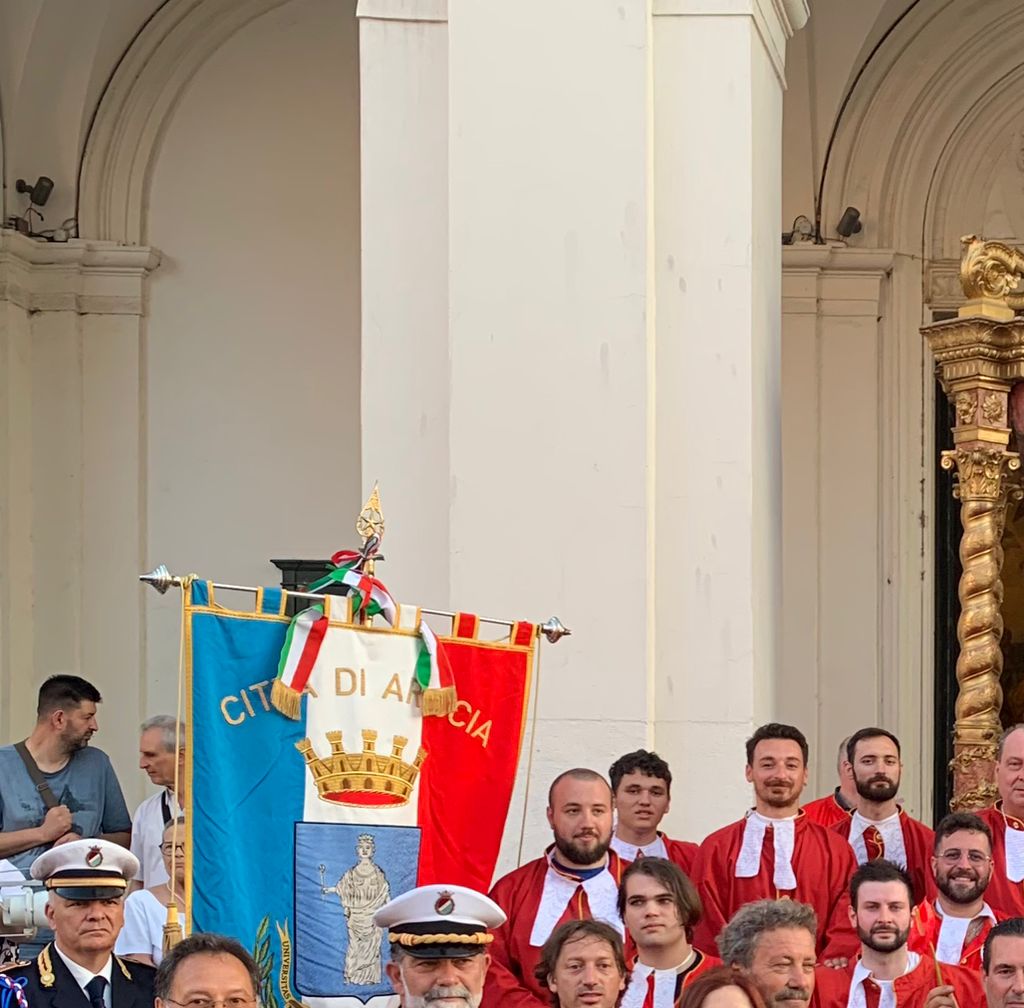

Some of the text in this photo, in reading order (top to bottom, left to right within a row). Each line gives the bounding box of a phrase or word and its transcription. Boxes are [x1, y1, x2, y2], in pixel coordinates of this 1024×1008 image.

[335, 667, 365, 697] DI
[382, 673, 492, 748] ARCIA
[281, 940, 291, 999] UNIVERSITAS
